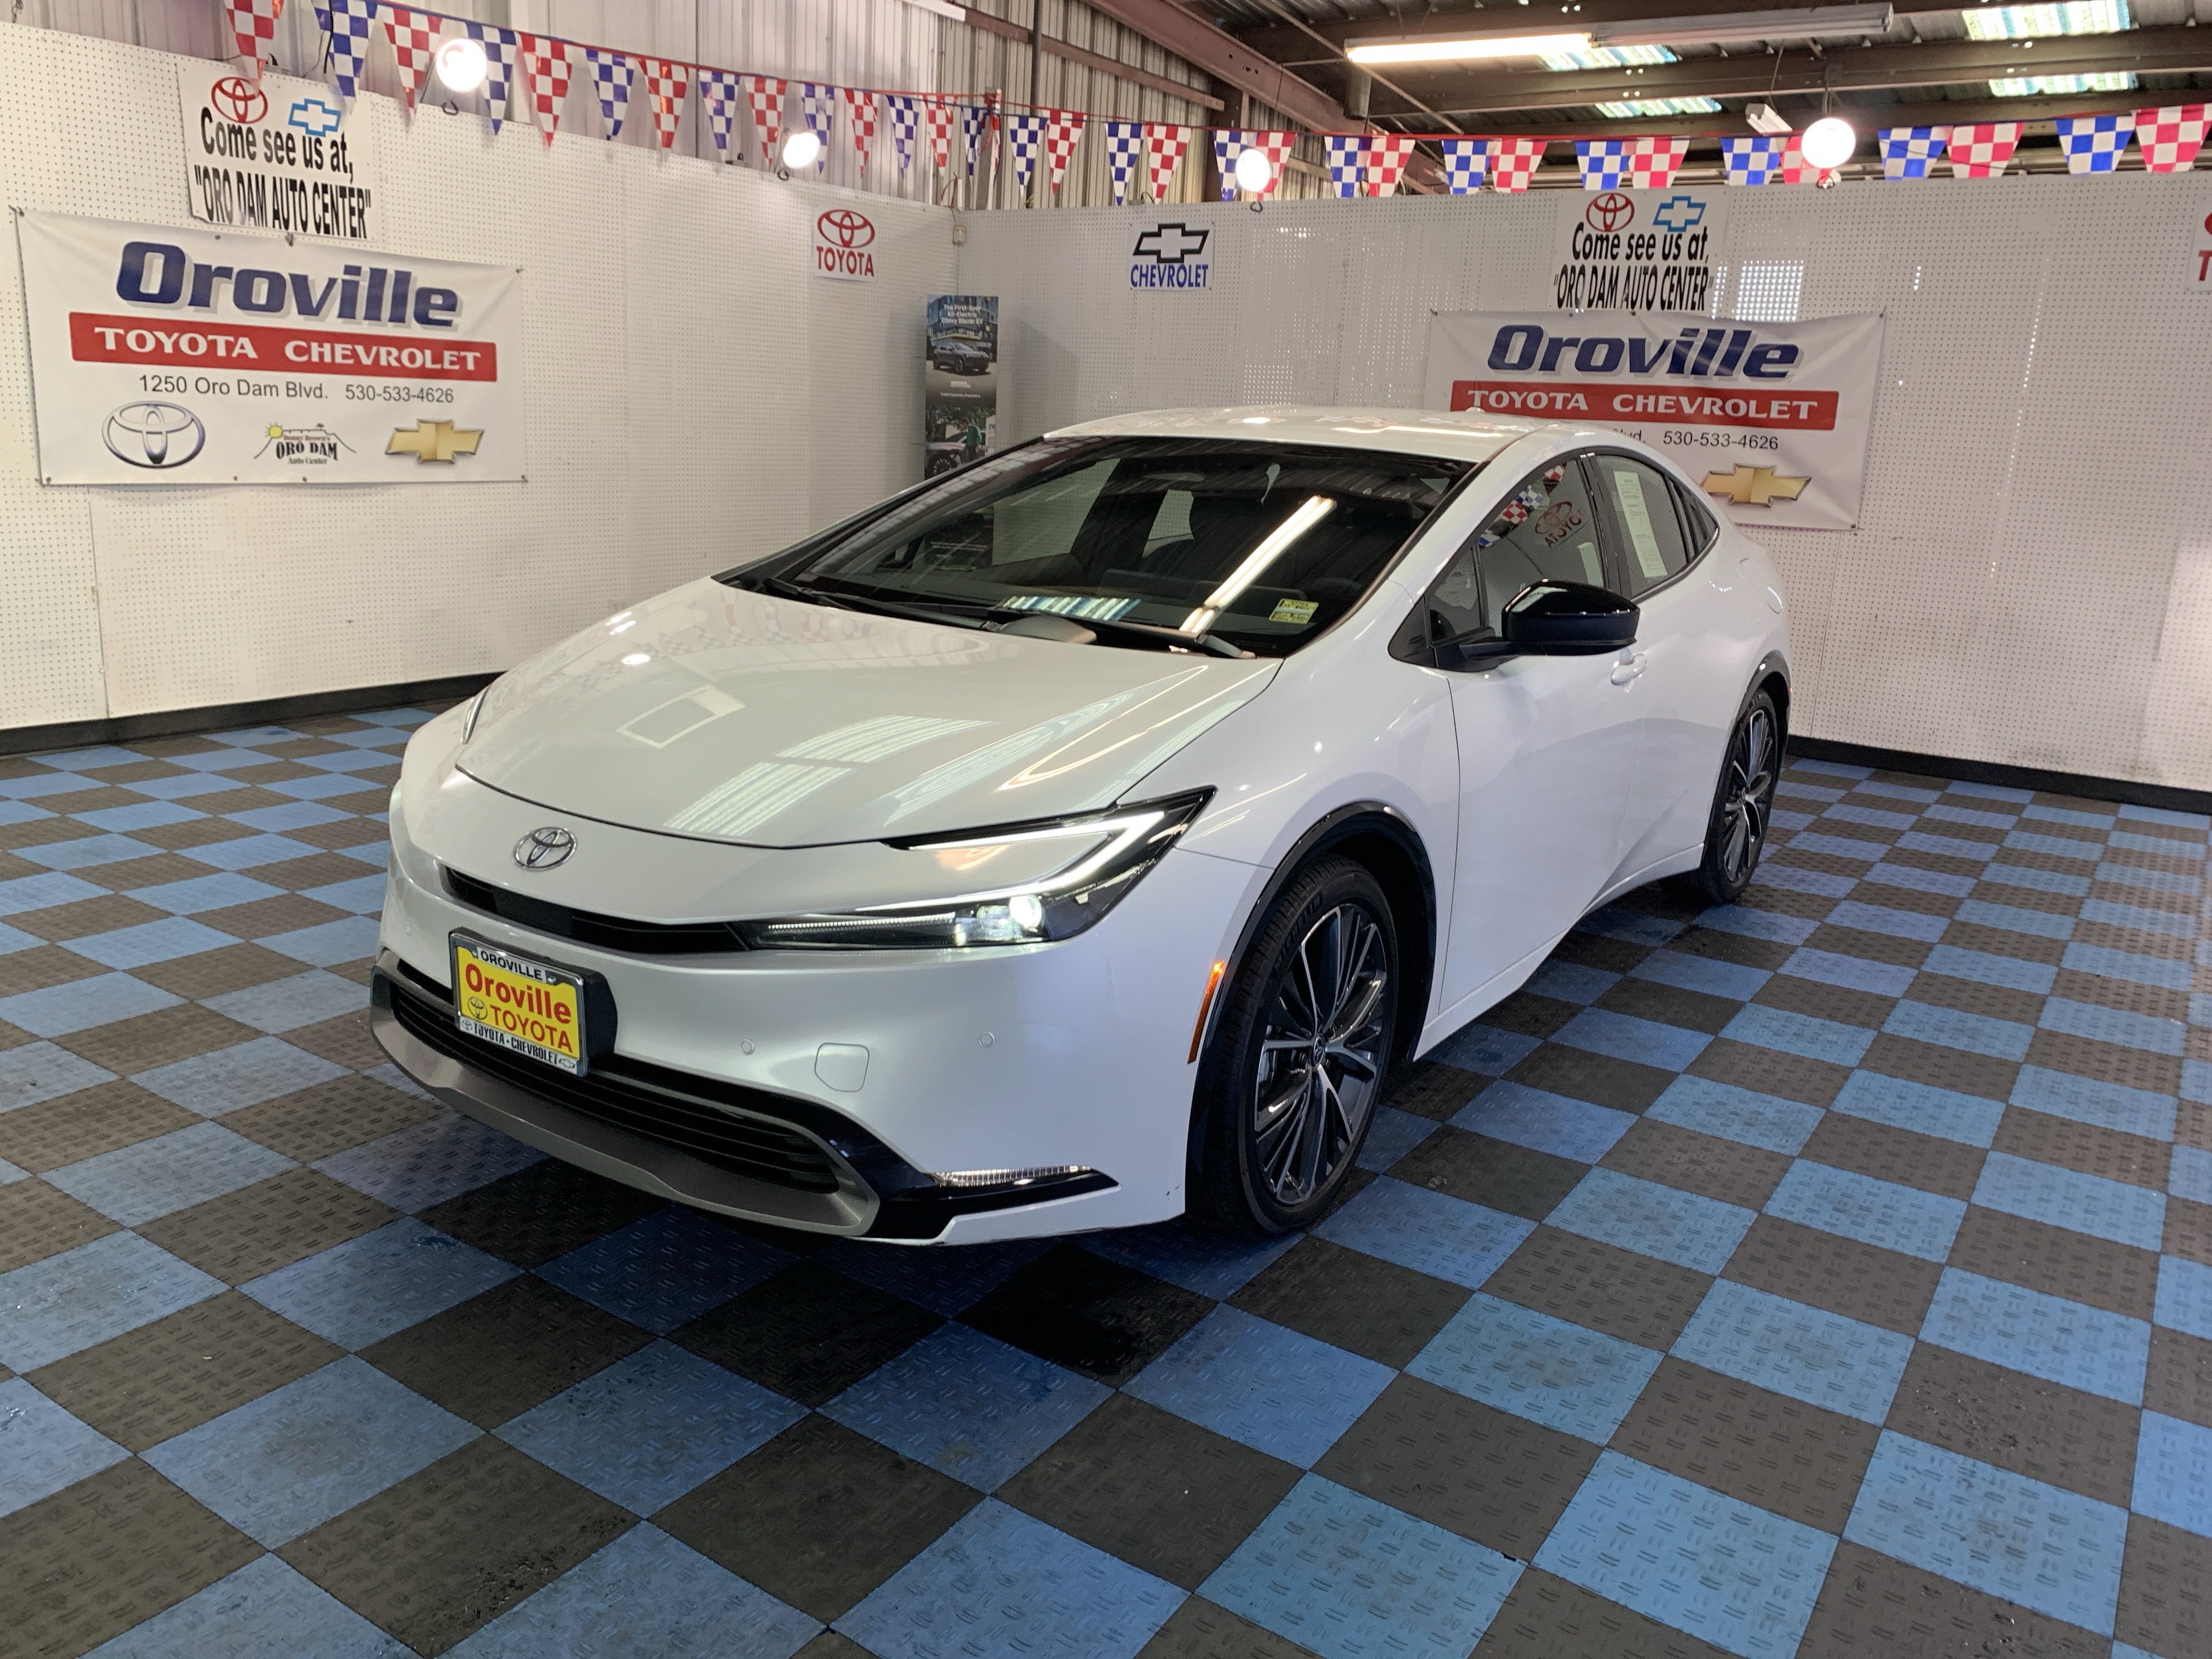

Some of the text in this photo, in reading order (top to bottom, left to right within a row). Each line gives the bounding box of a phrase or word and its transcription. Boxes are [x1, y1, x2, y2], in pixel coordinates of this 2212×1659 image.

[201, 106, 353, 184] Come see us at,
[194, 165, 371, 239] "ORO DAM AUTO CENTER"
[816, 246, 874, 277] TOYOTA
[1572, 221, 1708, 263] Come see us at,
[116, 241, 459, 326] Oroville
[1131, 264, 1209, 287] CHEVROLET
[1554, 263, 1714, 311] "ORO DAM AUTO CENTER"
[94, 327, 481, 371] TOYOTA CHEVROLET
[1487, 324, 1799, 377] Oroville
[140, 374, 329, 399] 1250 Oro Dam Blvd.
[345, 384, 454, 404] 530-533-4626
[1468, 389, 1818, 420] TOYOTA CHEVROLET
[276, 441, 338, 461] ORO DAM
[1662, 430, 1779, 450] 530-533-4626
[481, 950, 543, 981] OROVILLE
[465, 963, 571, 1024] Oroville
[474, 1022, 558, 1065] TOYOTA CHEVROLET
[490, 1004, 573, 1053] TOYOTA
